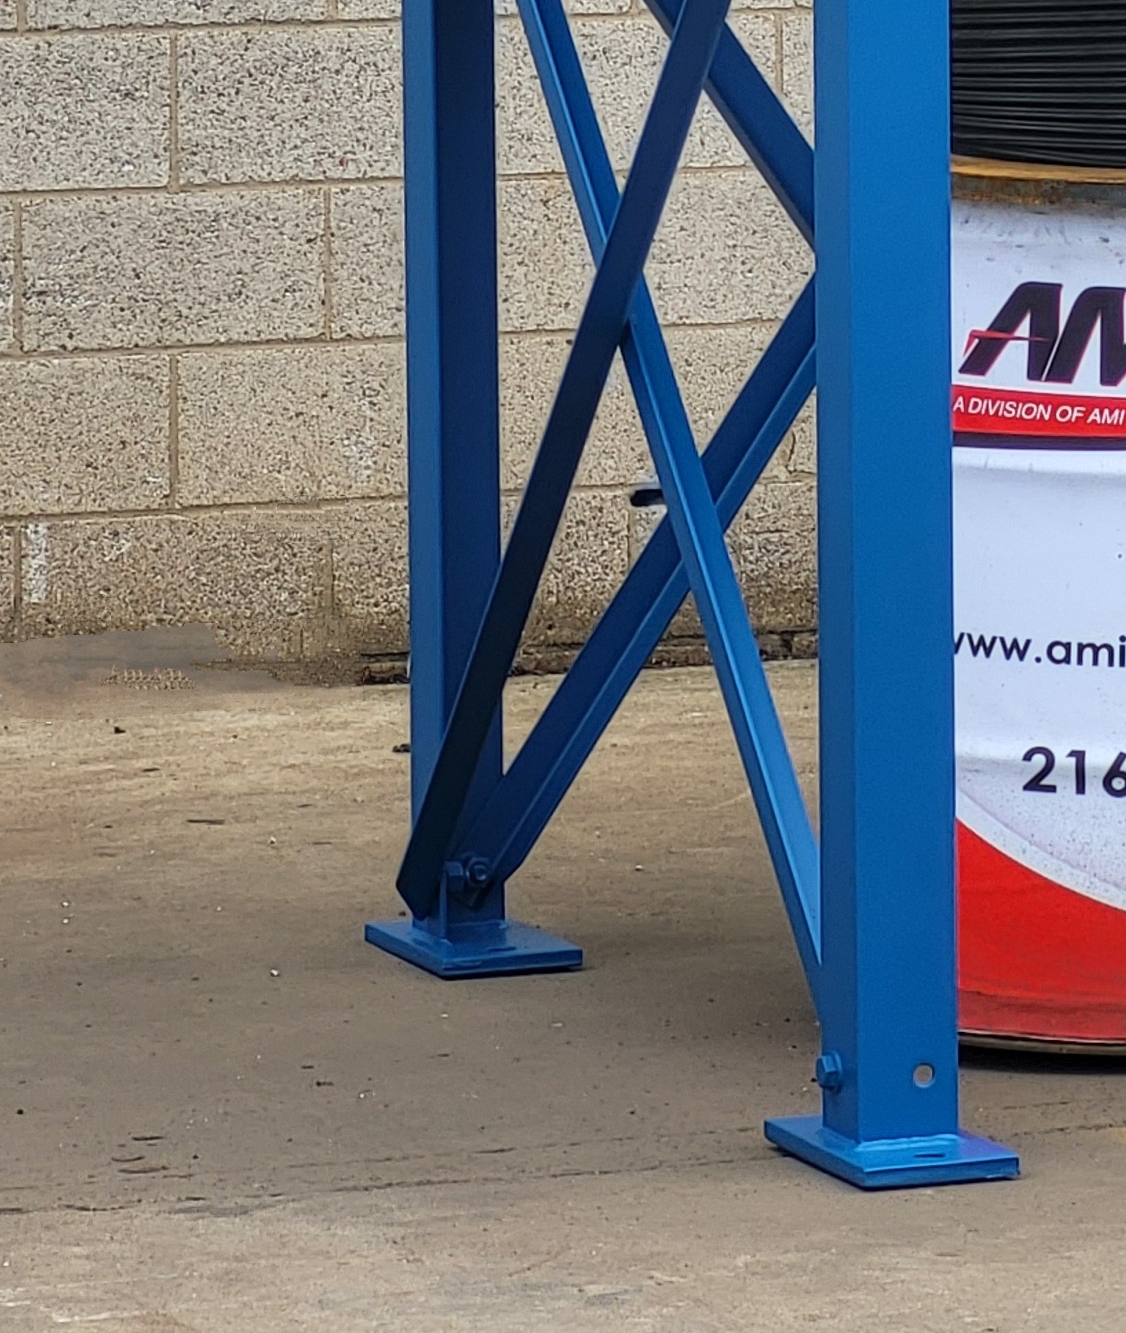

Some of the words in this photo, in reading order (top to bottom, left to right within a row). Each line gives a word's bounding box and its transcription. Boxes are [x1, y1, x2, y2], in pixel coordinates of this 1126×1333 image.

[952, 396, 965, 413] A
[968, 397, 1051, 421] DIVISION
[1055, 406, 1086, 422] OF
[1087, 408, 1126, 425] AMI
